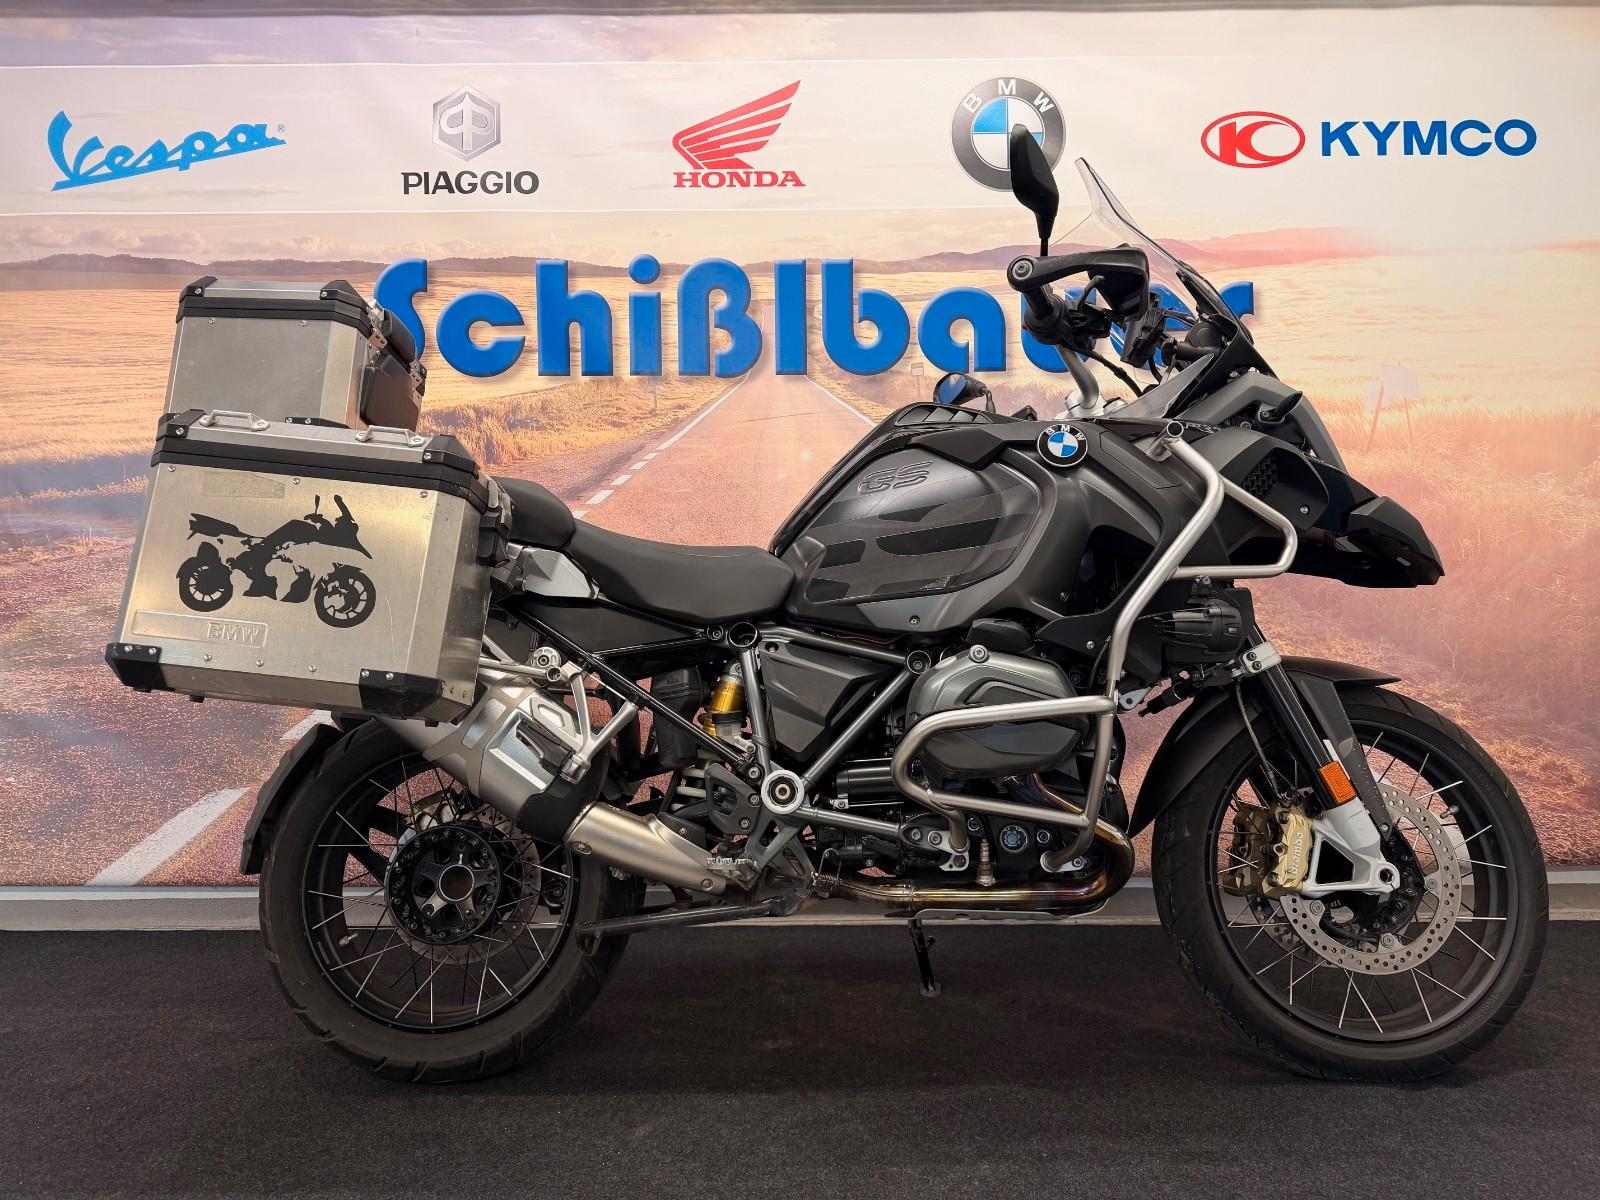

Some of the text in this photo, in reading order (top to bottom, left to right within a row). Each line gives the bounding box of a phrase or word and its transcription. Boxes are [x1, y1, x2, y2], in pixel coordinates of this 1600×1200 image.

[1321, 119, 1537, 157] KYMCO
[400, 170, 540, 195] PIAGGIO
[673, 170, 806, 188] HONDA
[1043, 424, 1086, 441] BMW
[858, 461, 933, 495] GS
[206, 622, 261, 643] BMW
